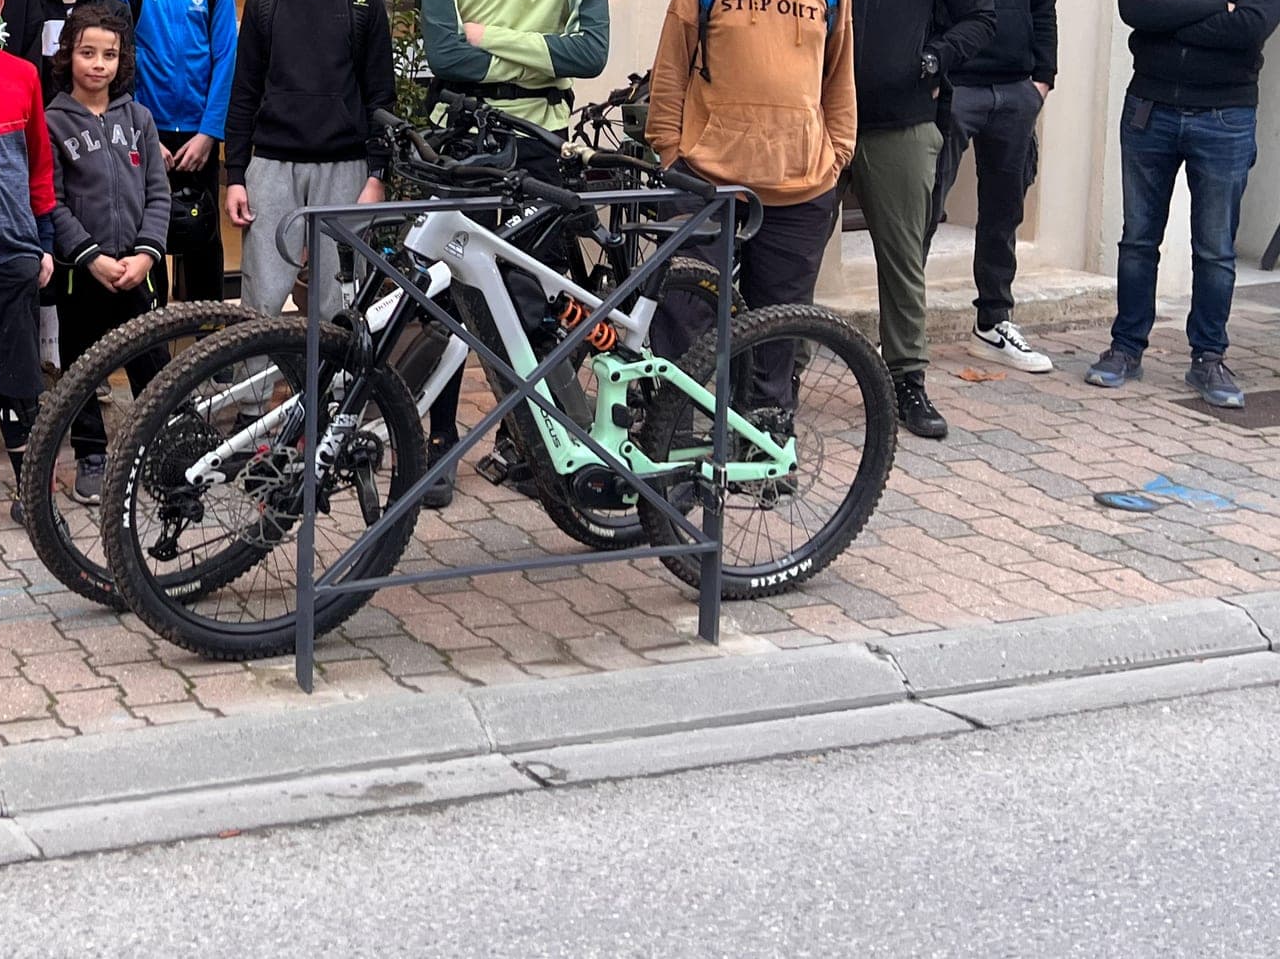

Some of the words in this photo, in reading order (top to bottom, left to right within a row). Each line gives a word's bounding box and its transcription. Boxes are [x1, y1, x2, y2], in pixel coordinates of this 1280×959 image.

[777, 0, 818, 20] OUT
[63, 123, 142, 162] PLAY
[540, 407, 561, 449] OCUS
[751, 558, 813, 588] MAXXIS
